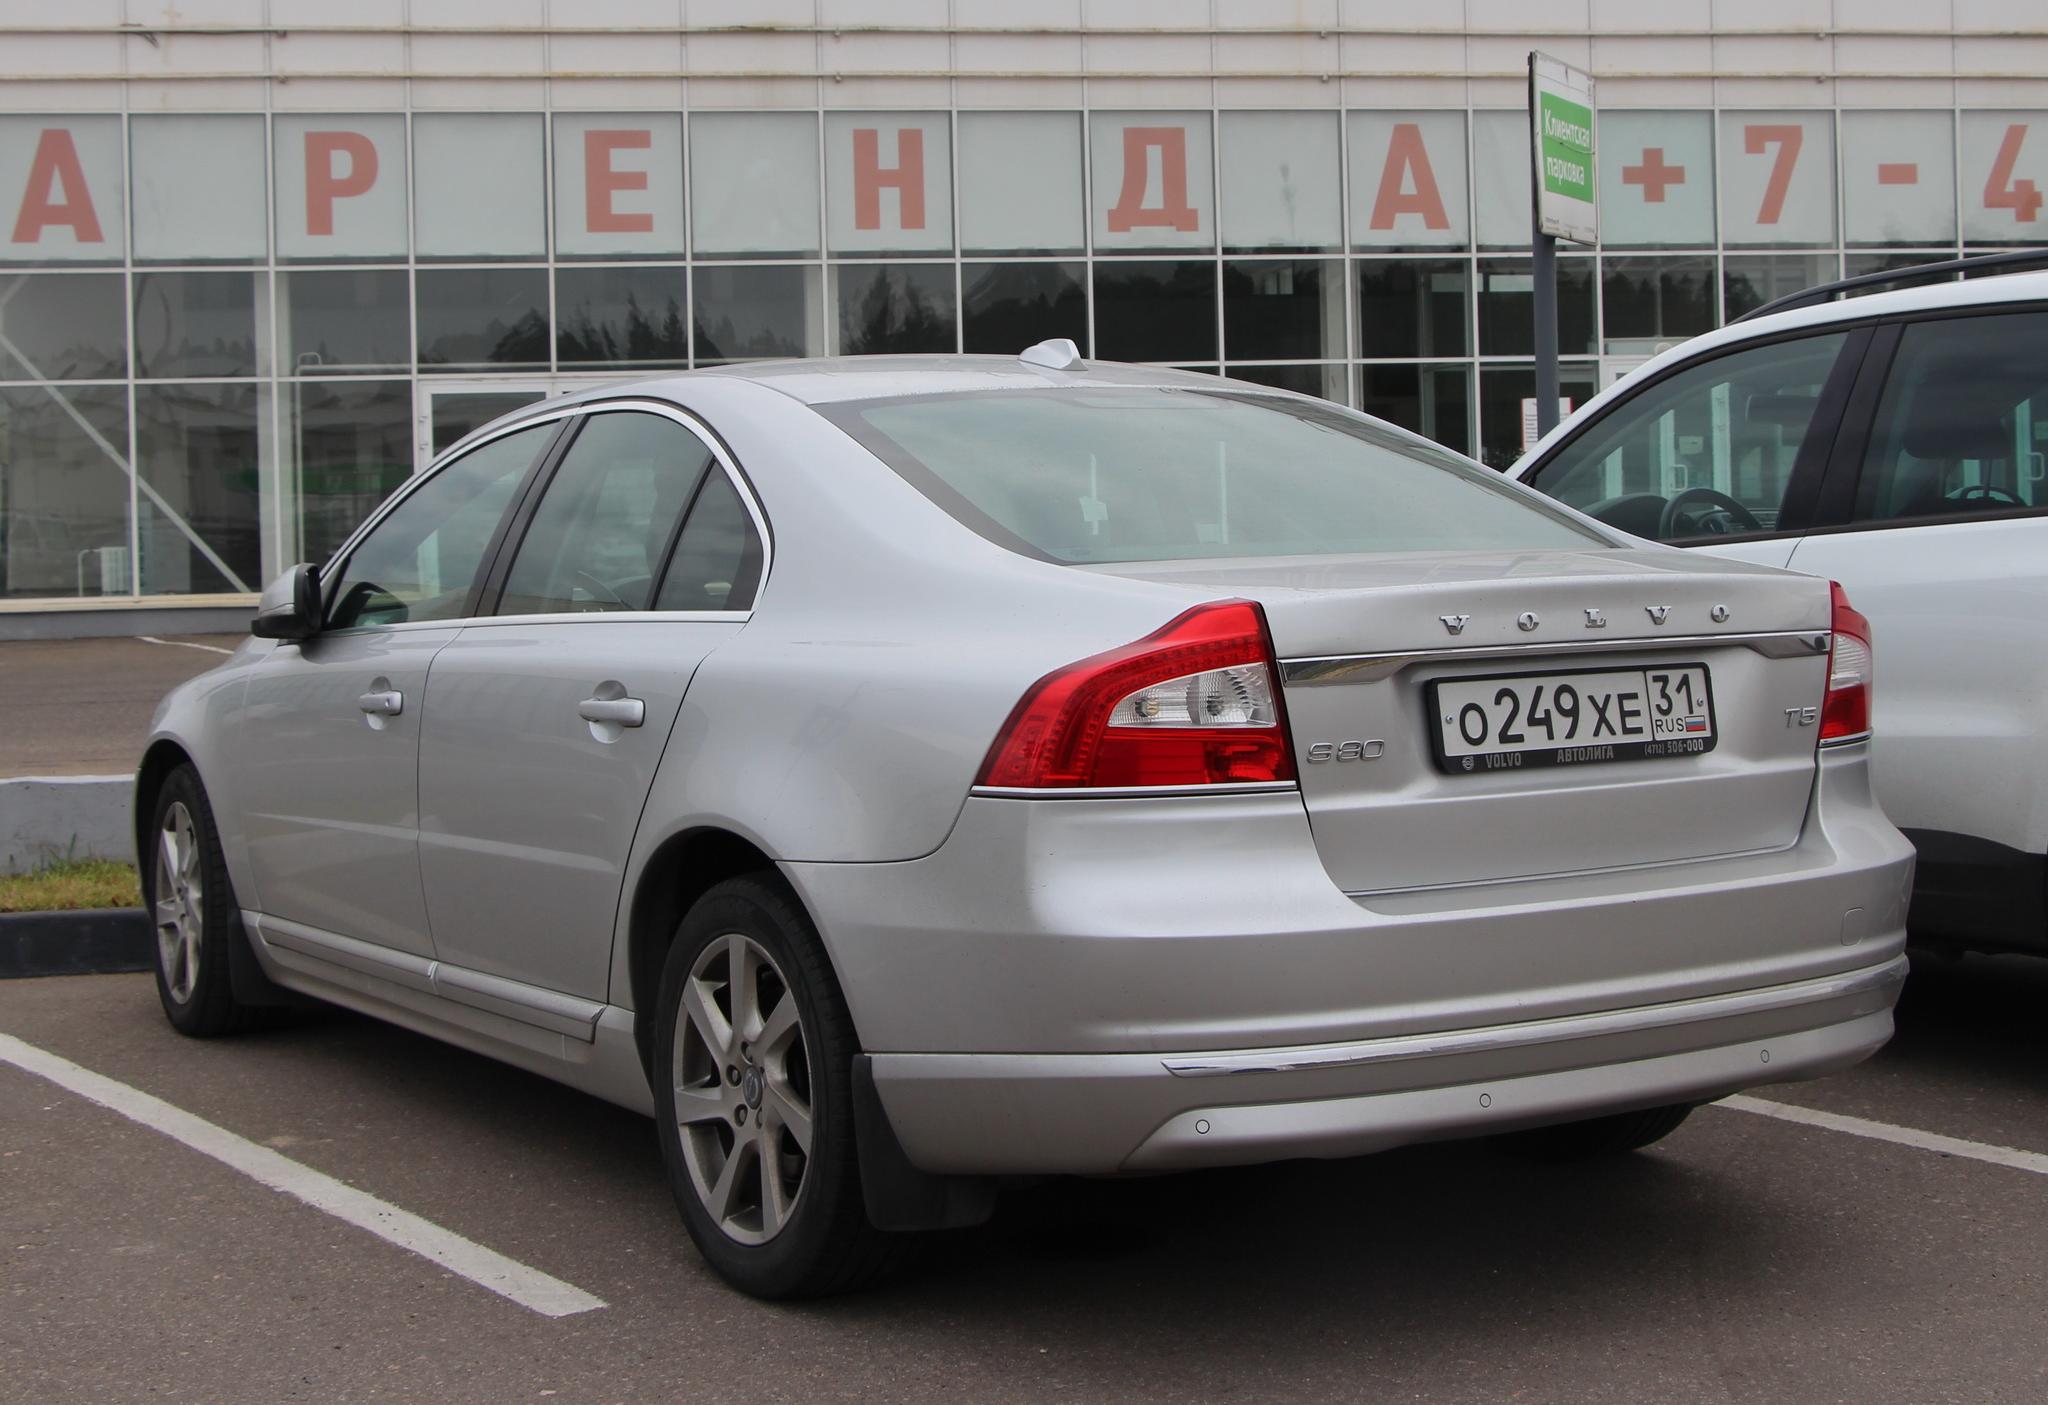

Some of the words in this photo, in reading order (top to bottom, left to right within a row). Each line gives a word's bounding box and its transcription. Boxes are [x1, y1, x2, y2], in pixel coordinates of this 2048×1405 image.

[1544, 108, 1590, 148] Клиентская
[11, 127, 1450, 242] АРЕНДА
[1547, 156, 1585, 186] парковка
[1439, 604, 1730, 636] VOLVO
[1652, 673, 1694, 716] 31
[1655, 717, 1684, 734] RUS
[1784, 706, 1817, 728] T5
[1307, 739, 1385, 764] S80
[1486, 753, 1522, 769] VOLVO
[1556, 745, 1615, 763] АВТОЛИГА
